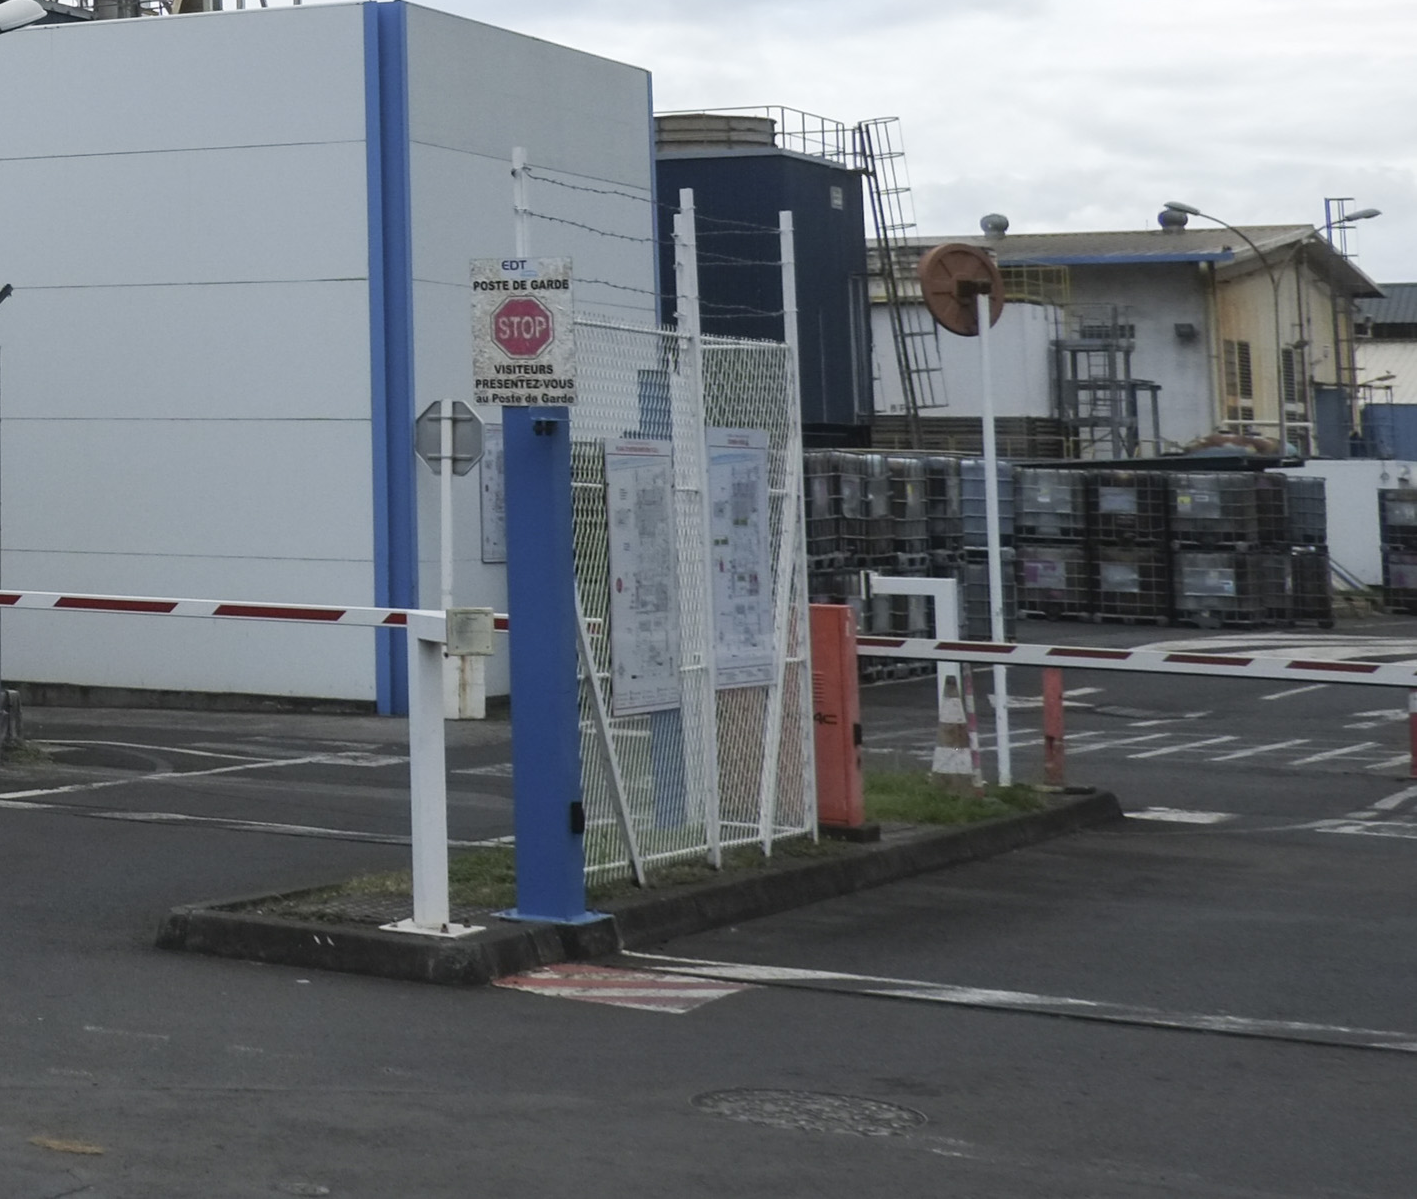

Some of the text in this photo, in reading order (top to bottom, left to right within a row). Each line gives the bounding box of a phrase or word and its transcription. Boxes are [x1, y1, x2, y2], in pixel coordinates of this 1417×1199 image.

[501, 259, 527, 271] EDT
[473, 279, 570, 291] POSTE DE GARDE
[498, 316, 547, 340] STOP
[494, 364, 554, 375] VISITEURS
[475, 378, 574, 389] PRESENTEZ-VOUS
[476, 393, 575, 404] au Poste de Garde
